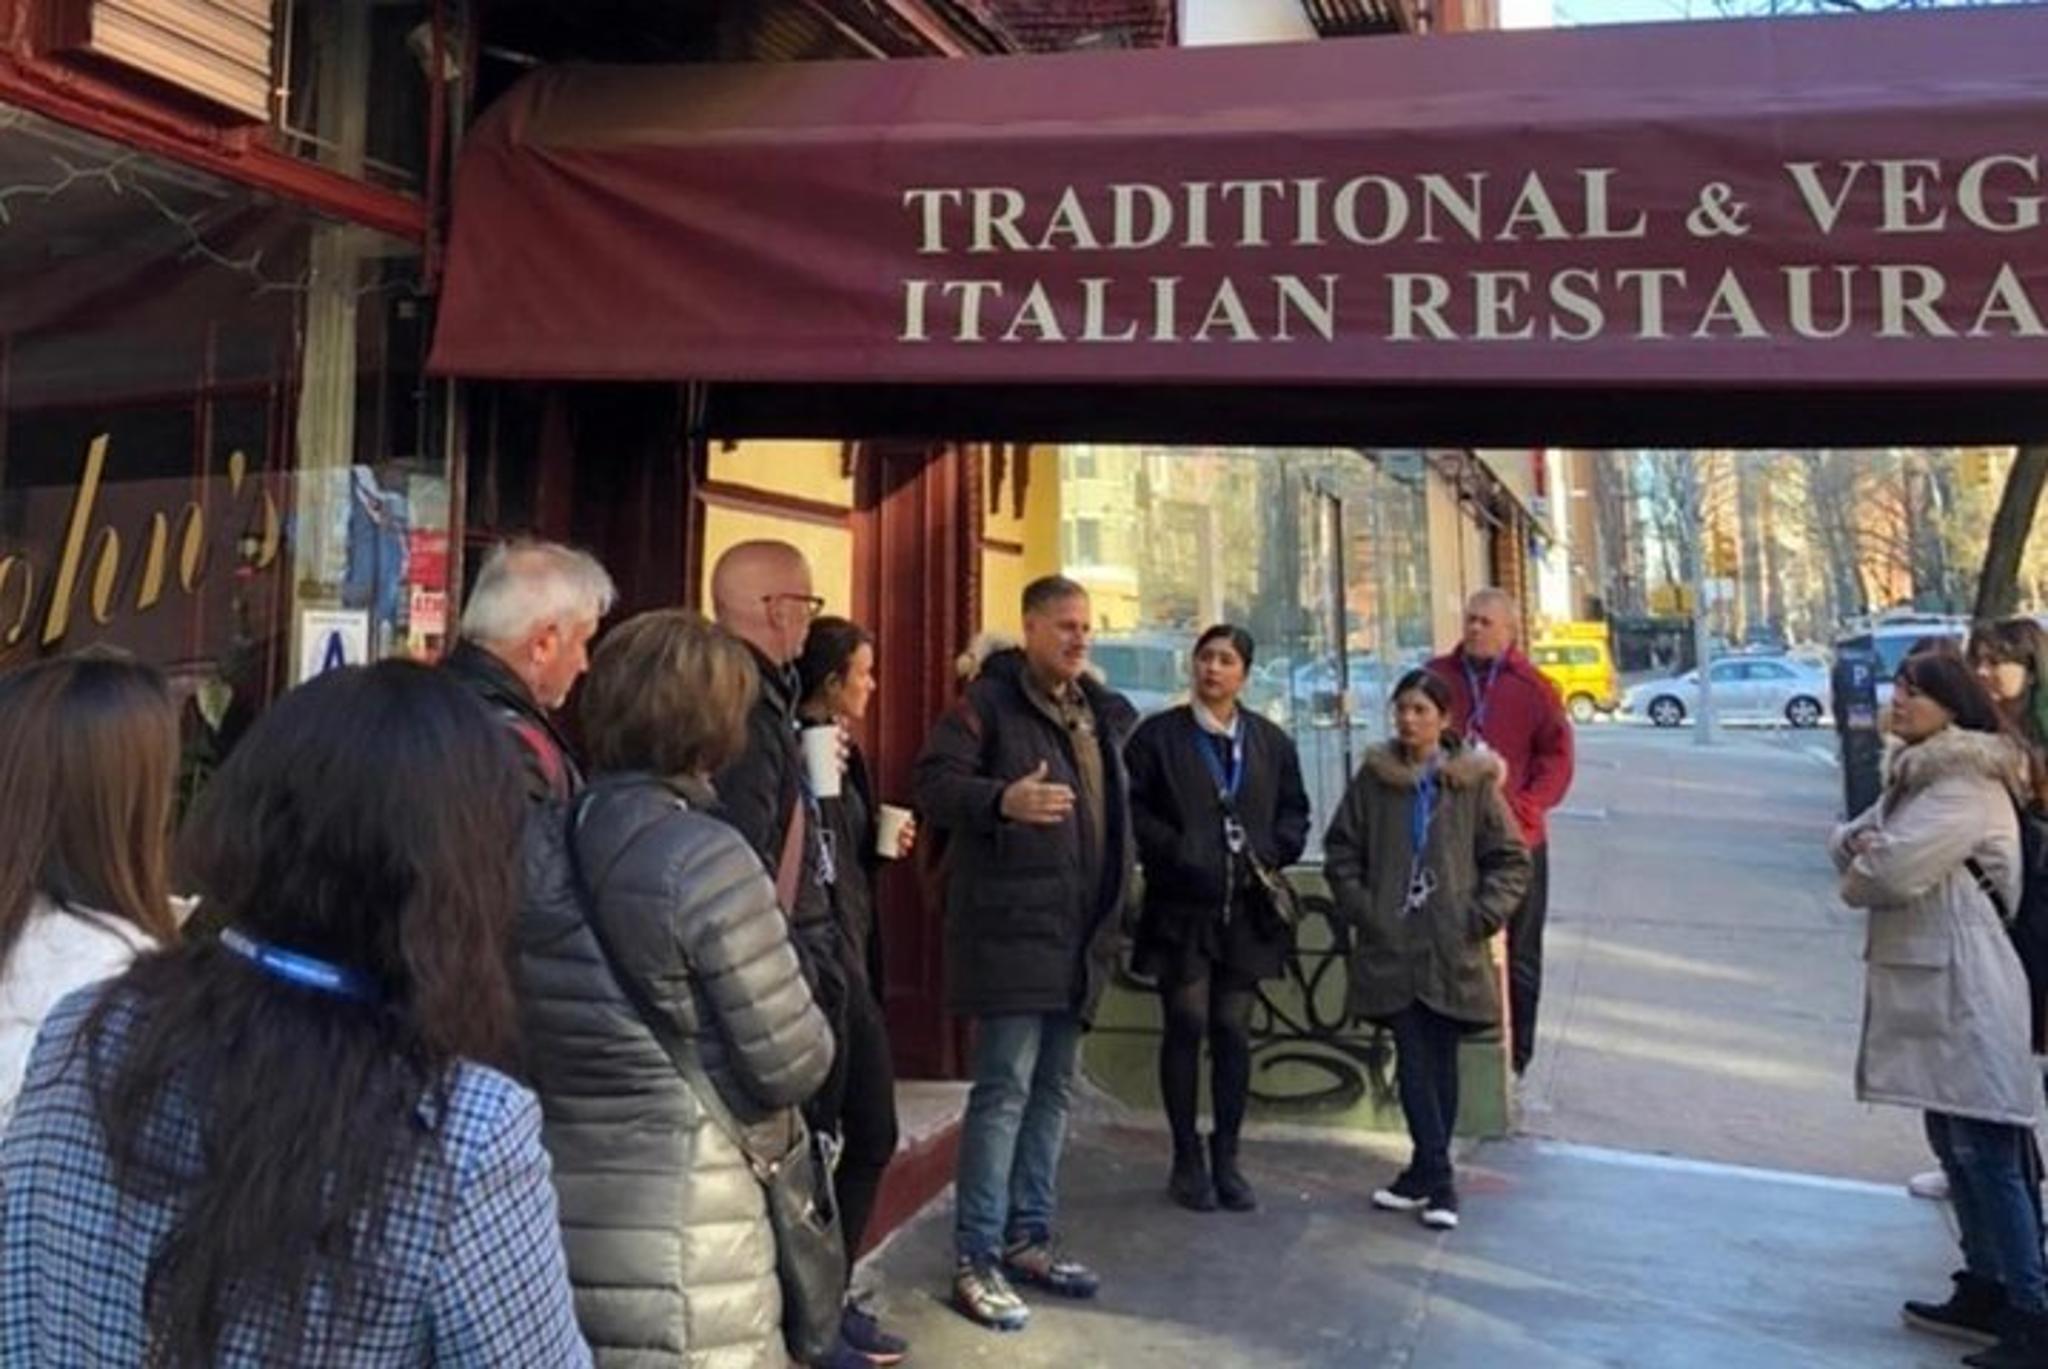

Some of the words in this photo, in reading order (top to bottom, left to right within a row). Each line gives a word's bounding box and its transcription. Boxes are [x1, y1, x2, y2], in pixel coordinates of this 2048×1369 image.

[903, 167, 1648, 253] TRADITIONAL
[1685, 181, 1752, 238] &
[1784, 154, 2047, 236] VEG
[898, 273, 1340, 344] ITALIAN
[1384, 262, 2048, 343] RESTAURA
